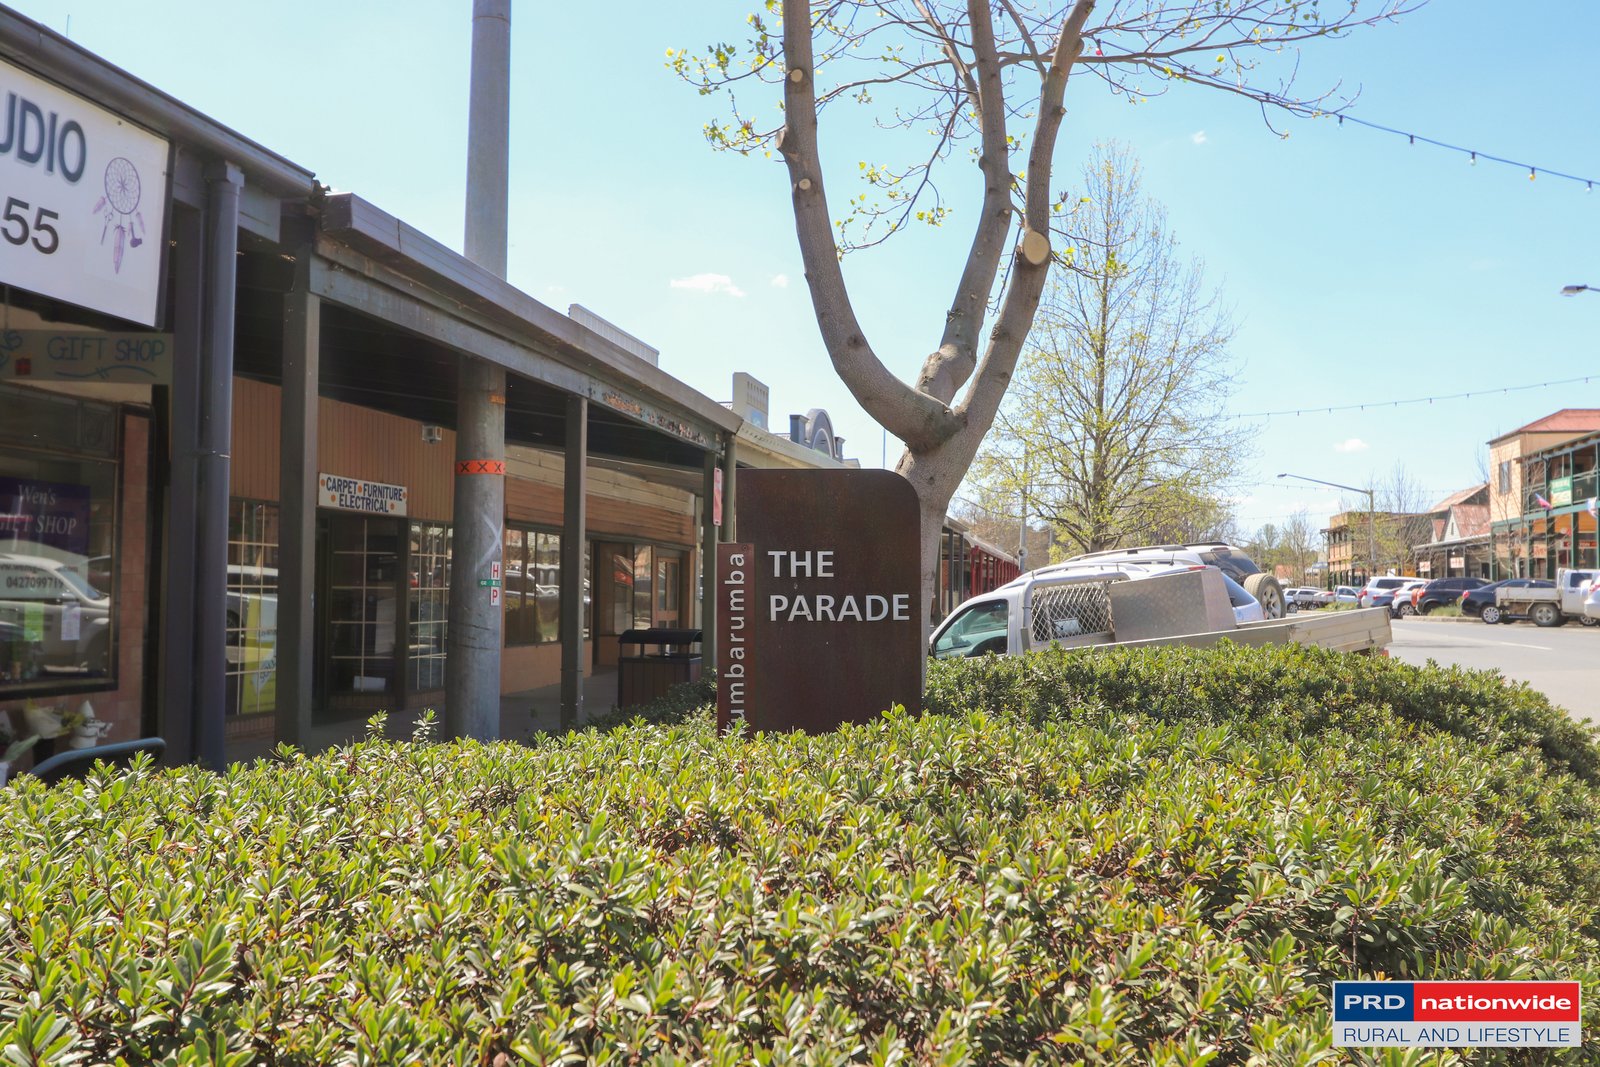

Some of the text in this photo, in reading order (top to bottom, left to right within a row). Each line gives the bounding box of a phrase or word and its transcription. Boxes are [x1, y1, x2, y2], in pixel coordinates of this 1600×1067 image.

[47, 336, 108, 361] GIFT
[114, 338, 165, 362] SHOP
[18, 484, 57, 506] Wen's
[326, 476, 403, 502] CARPET FURNITURE
[339, 493, 389, 513] ELECTRICAL
[35, 515, 77, 536] SHOP
[493, 565, 499, 578] H
[768, 550, 835, 578] THE
[492, 590, 498, 603] P
[769, 593, 910, 622] PARADE
[724, 553, 745, 736] umbarumba
